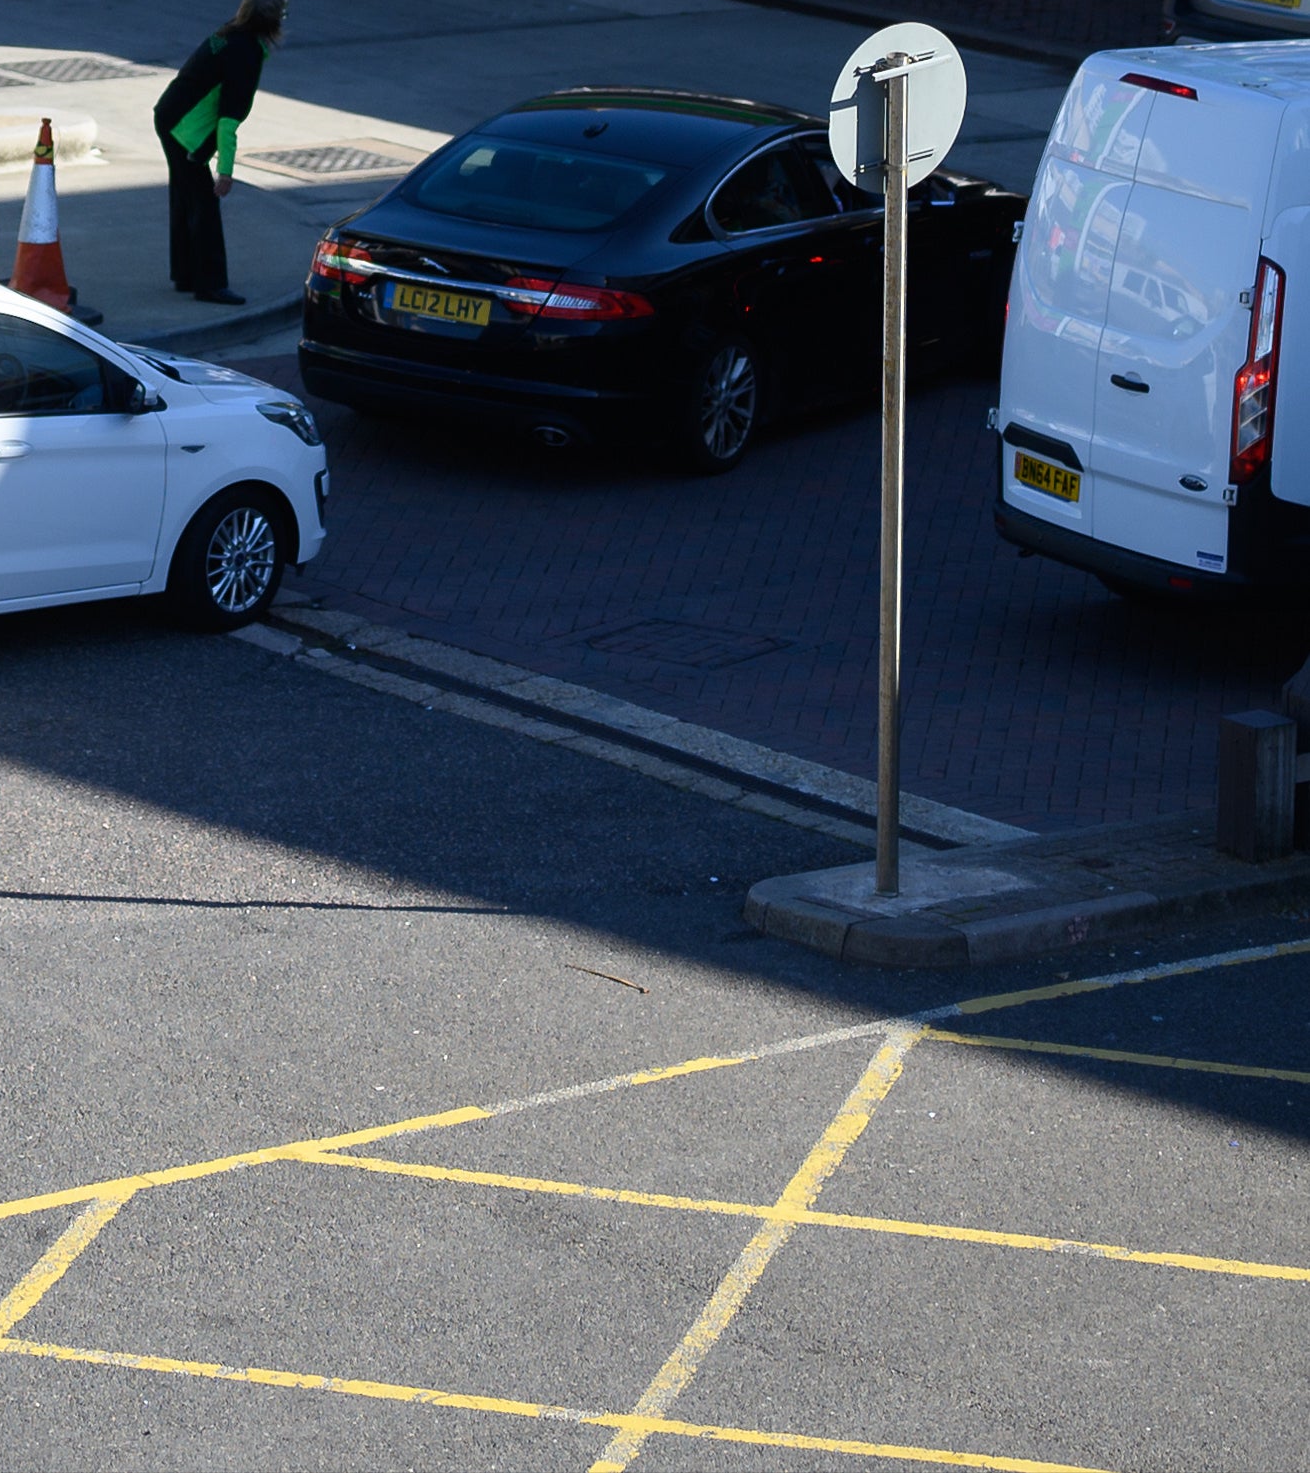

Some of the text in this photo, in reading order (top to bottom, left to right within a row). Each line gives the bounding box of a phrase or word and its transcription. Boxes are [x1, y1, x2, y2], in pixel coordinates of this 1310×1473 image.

[398, 283, 484, 321] LC12 LHY
[1020, 456, 1078, 497] BN64 FAF
